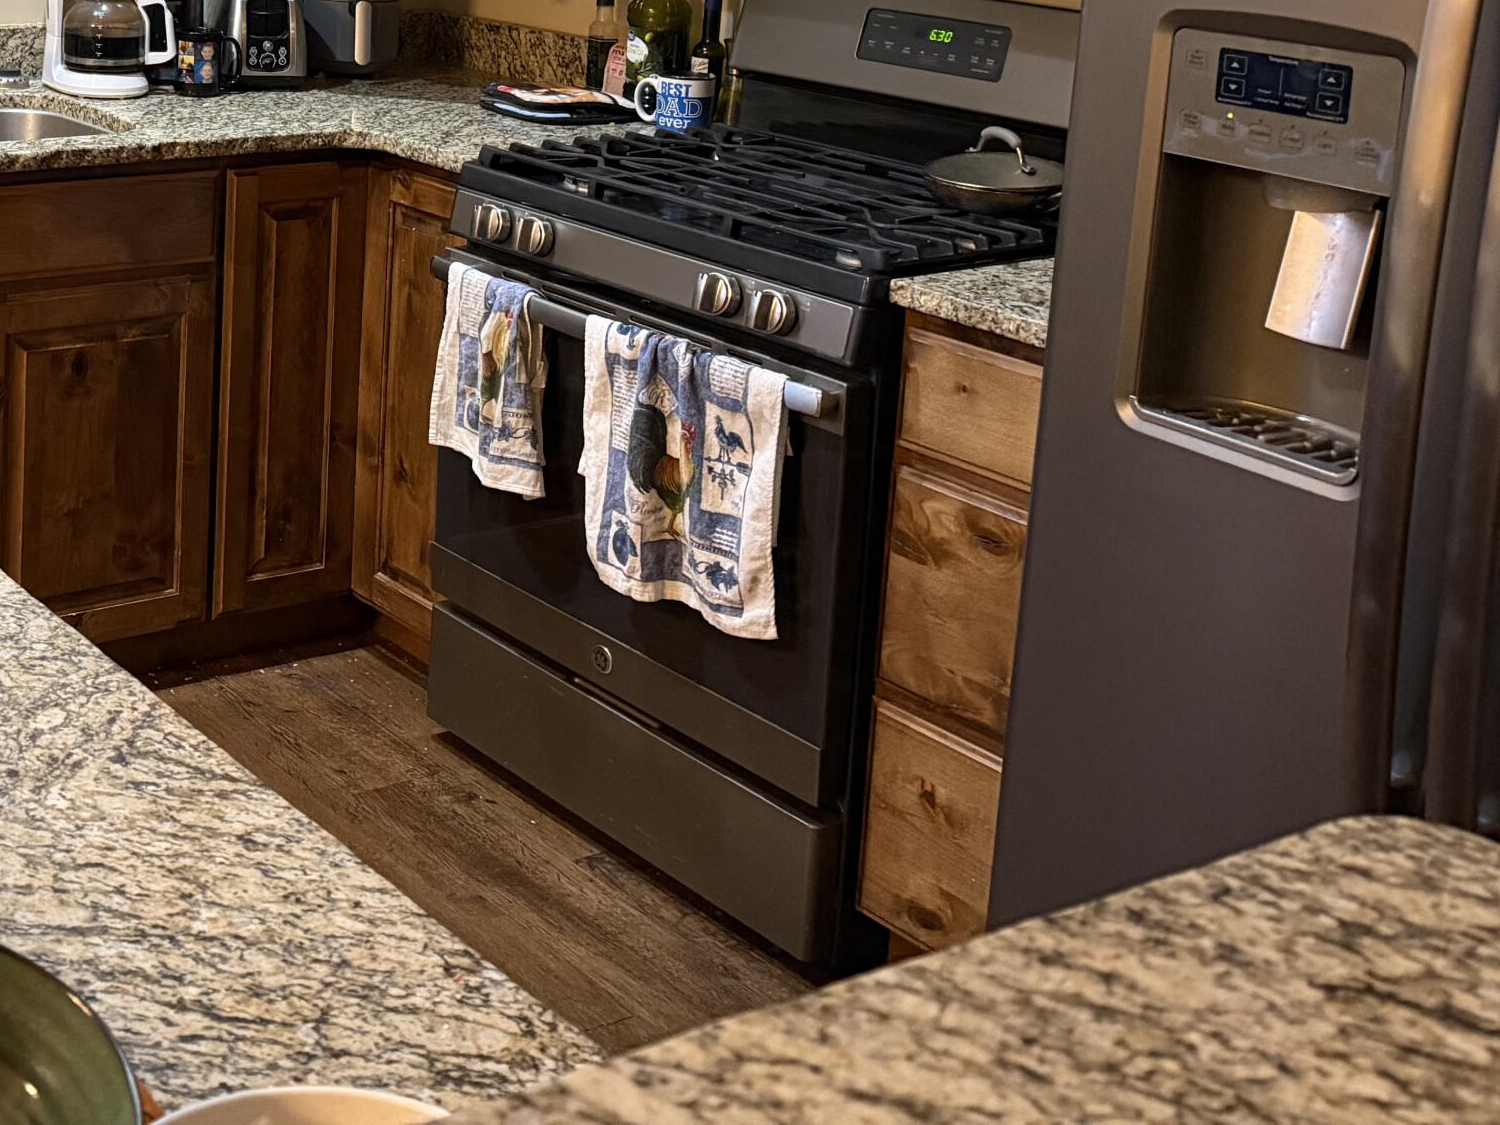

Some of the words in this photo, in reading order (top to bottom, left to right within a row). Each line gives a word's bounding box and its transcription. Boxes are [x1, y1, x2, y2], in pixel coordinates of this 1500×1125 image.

[661, 81, 693, 98] BEST
[655, 95, 704, 118] DAD
[658, 115, 692, 129] ever
